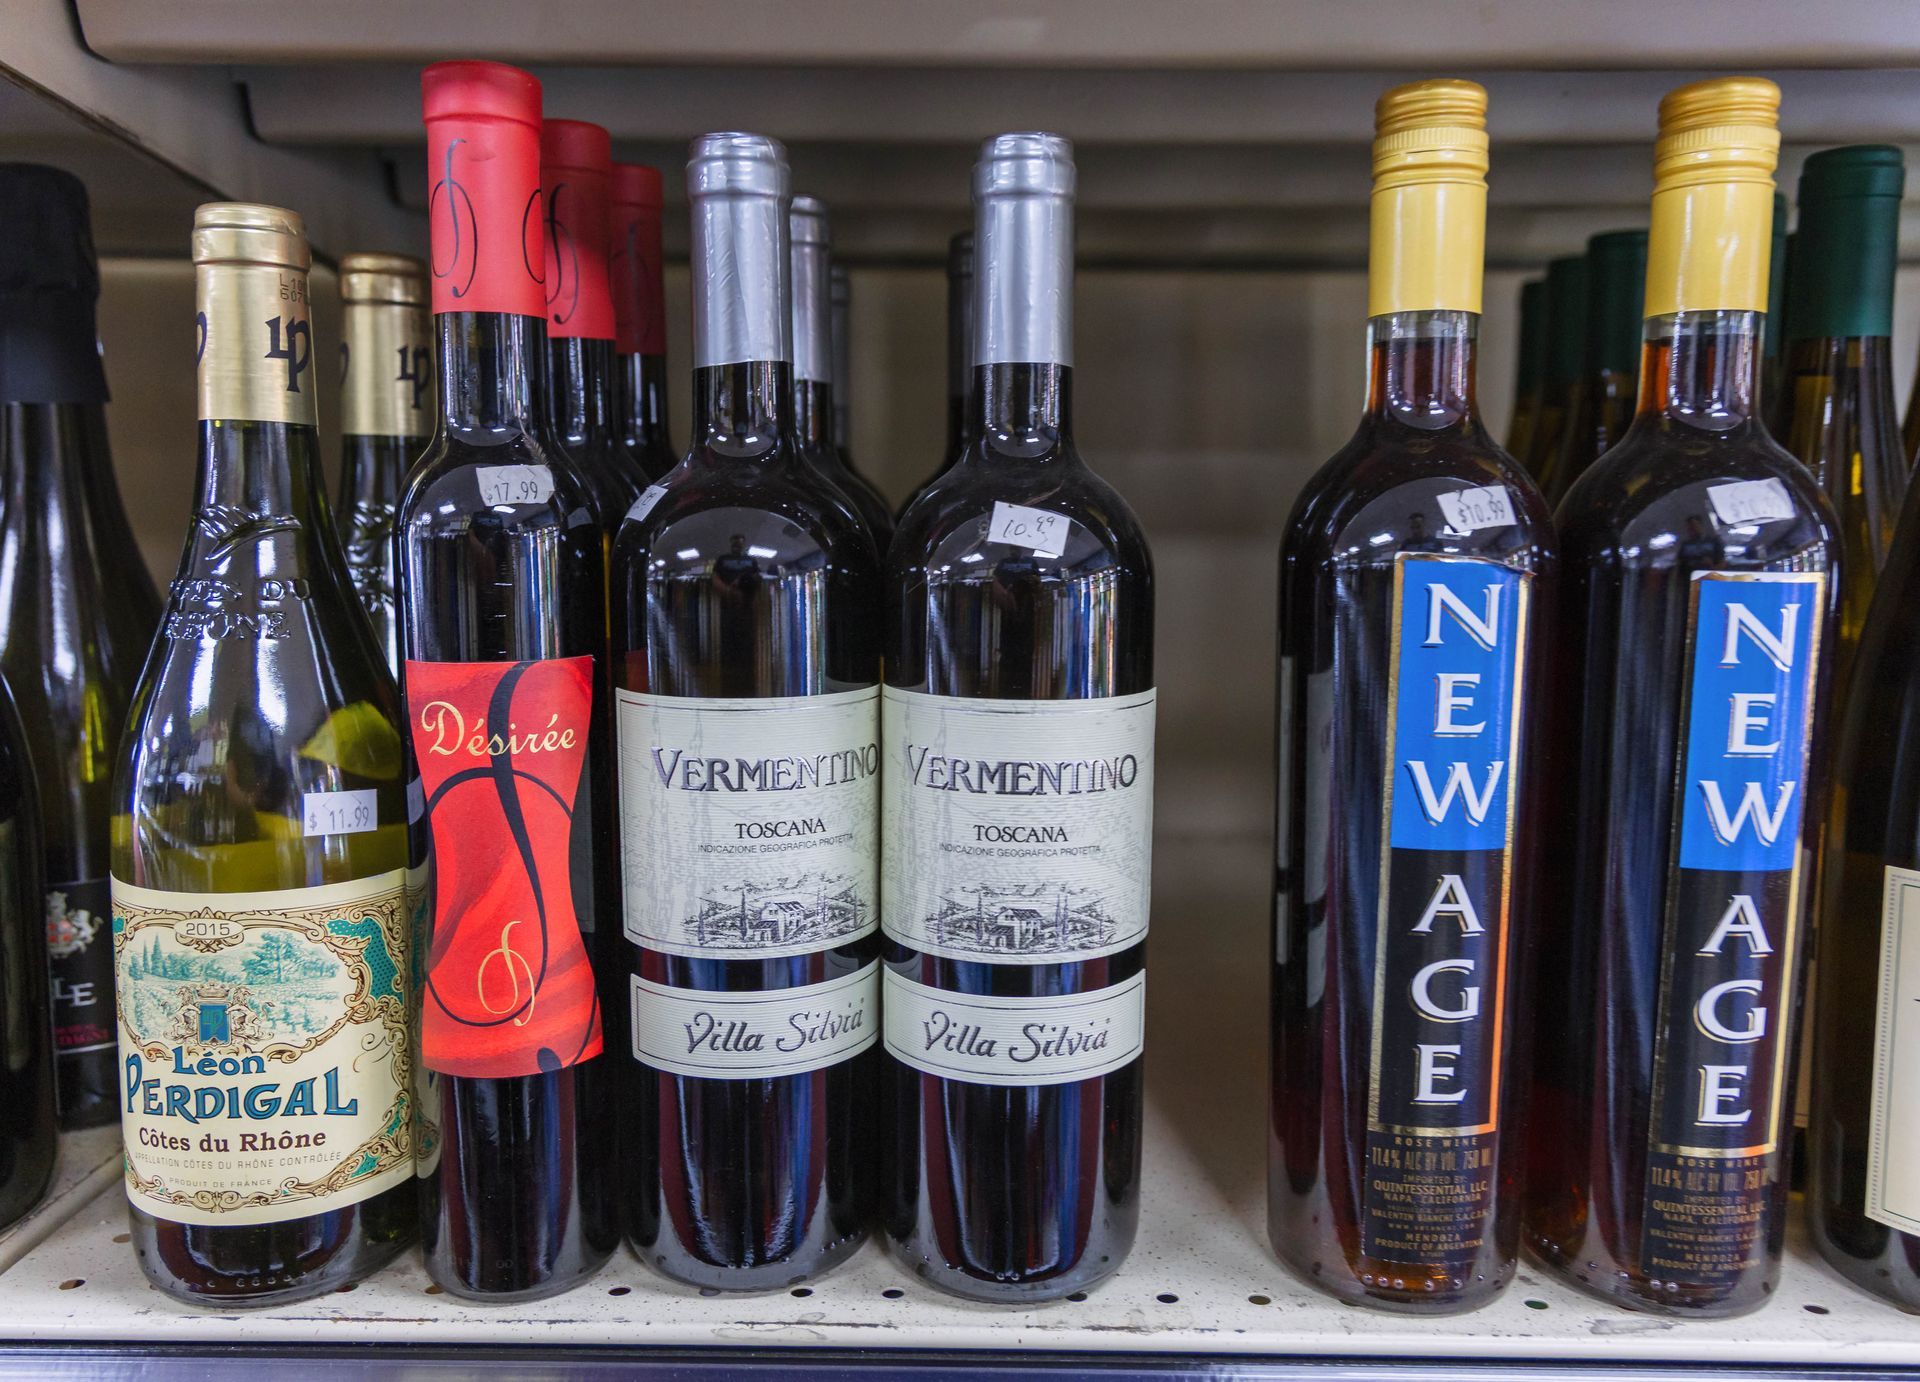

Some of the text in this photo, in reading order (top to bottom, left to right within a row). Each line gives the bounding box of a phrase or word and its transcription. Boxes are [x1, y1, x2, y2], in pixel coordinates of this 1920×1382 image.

[1458, 500, 1505, 526] $10.99
[1404, 583, 1505, 828] NEW
[421, 701, 577, 756] Désirée
[1697, 603, 1802, 848] NEW
[651, 743, 879, 793] VERMENTINO
[906, 744, 1138, 796] VERMENTINO
[734, 817, 827, 840] TOSCANA
[973, 824, 1069, 844] TOSCANA
[697, 833, 854, 854] INDICAZIONE GEOGRAFICA PROTETTA
[940, 843, 1101, 858] INDICAZIONE GEOGRAFICA PROTETTA
[185, 921, 231, 937] 2015
[1407, 874, 1486, 1105] AGE
[1692, 894, 1774, 1127] AGE
[683, 1011, 765, 1054] Villa
[922, 1010, 998, 1058] Villa
[171, 1045, 267, 1076] Léon
[125, 1053, 359, 1125] PERDIGAL
[139, 1126, 326, 1153] Côtes du Rhône
[1394, 1136, 1478, 1148] ROSE WINE
[183, 1158, 213, 1169] CÔTES
[217, 1160, 233, 1170] DU
[237, 1158, 274, 1169] RHÔNE
[279, 1151, 342, 1167] CONTRÔLÉE
[168, 1177, 208, 1188] PRODUIT
[1373, 1180, 1467, 1195] QUINTESSENTIAL
[1420, 1193, 1481, 1204] CALIFORNIA
[1375, 1237, 1419, 1250] PRODUCT
[1405, 1233, 1461, 1242] MENDOZA
